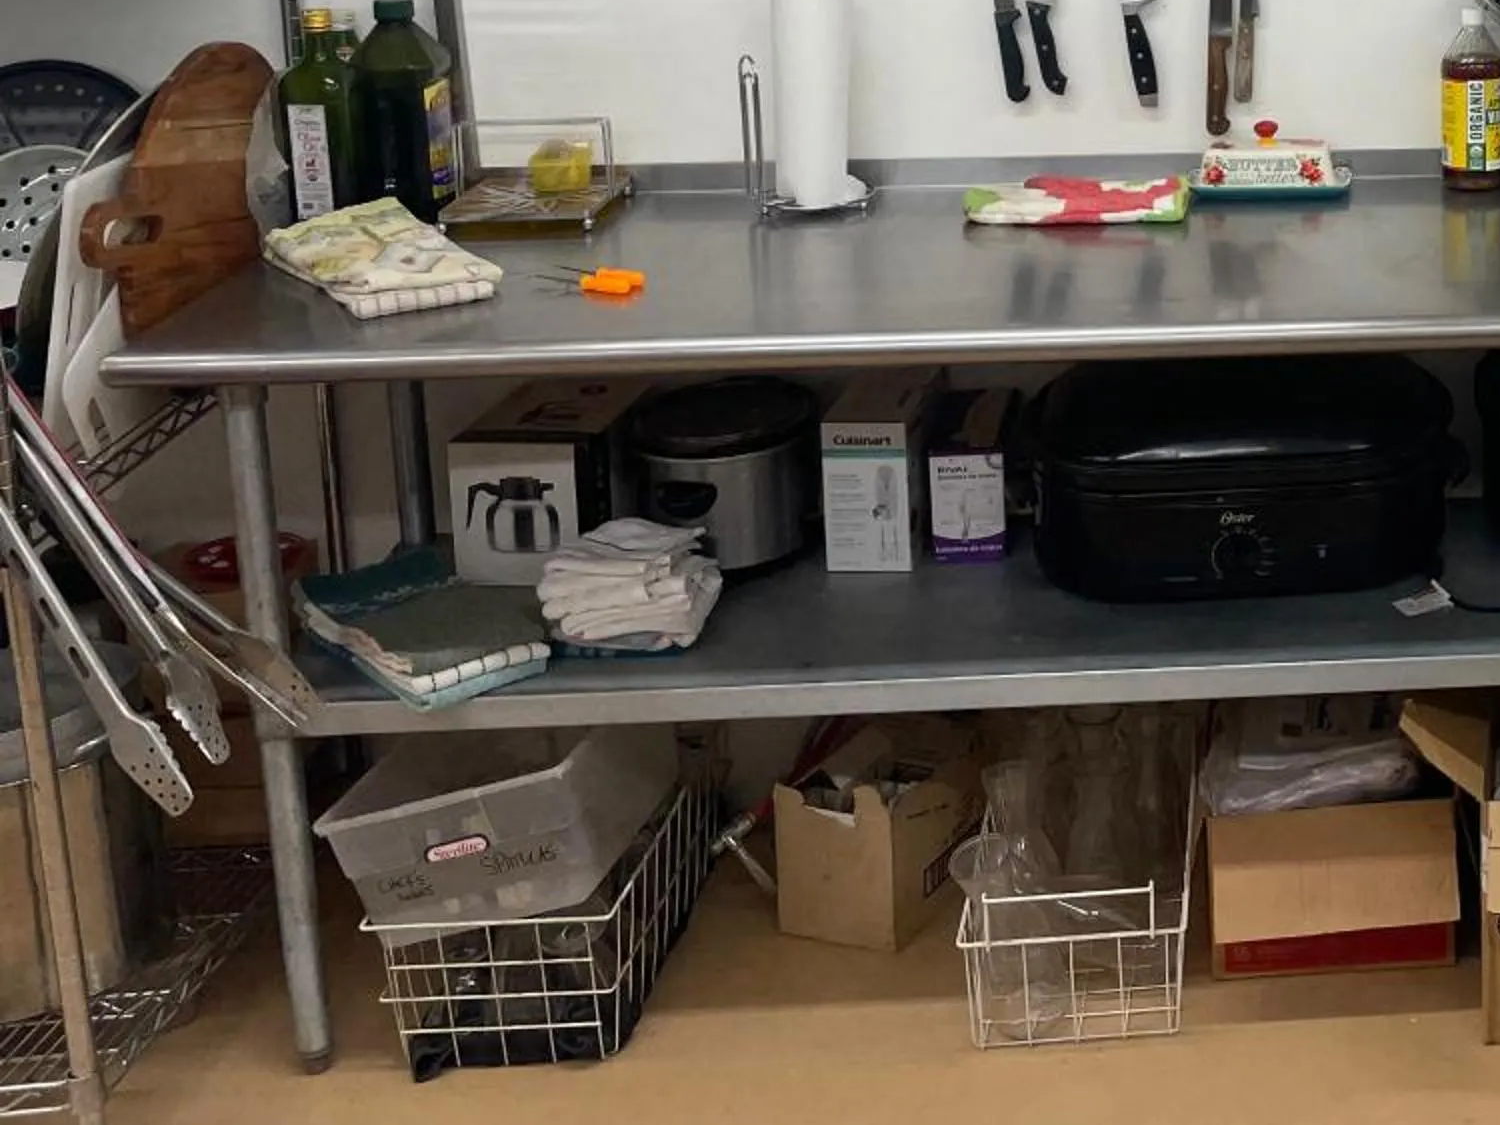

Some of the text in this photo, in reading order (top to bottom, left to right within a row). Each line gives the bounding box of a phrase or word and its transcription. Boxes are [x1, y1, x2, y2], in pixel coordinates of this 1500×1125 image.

[1469, 82, 1483, 140] ORGANIC
[1227, 158, 1298, 172] BUTTER
[832, 434, 892, 446] Cuisinart
